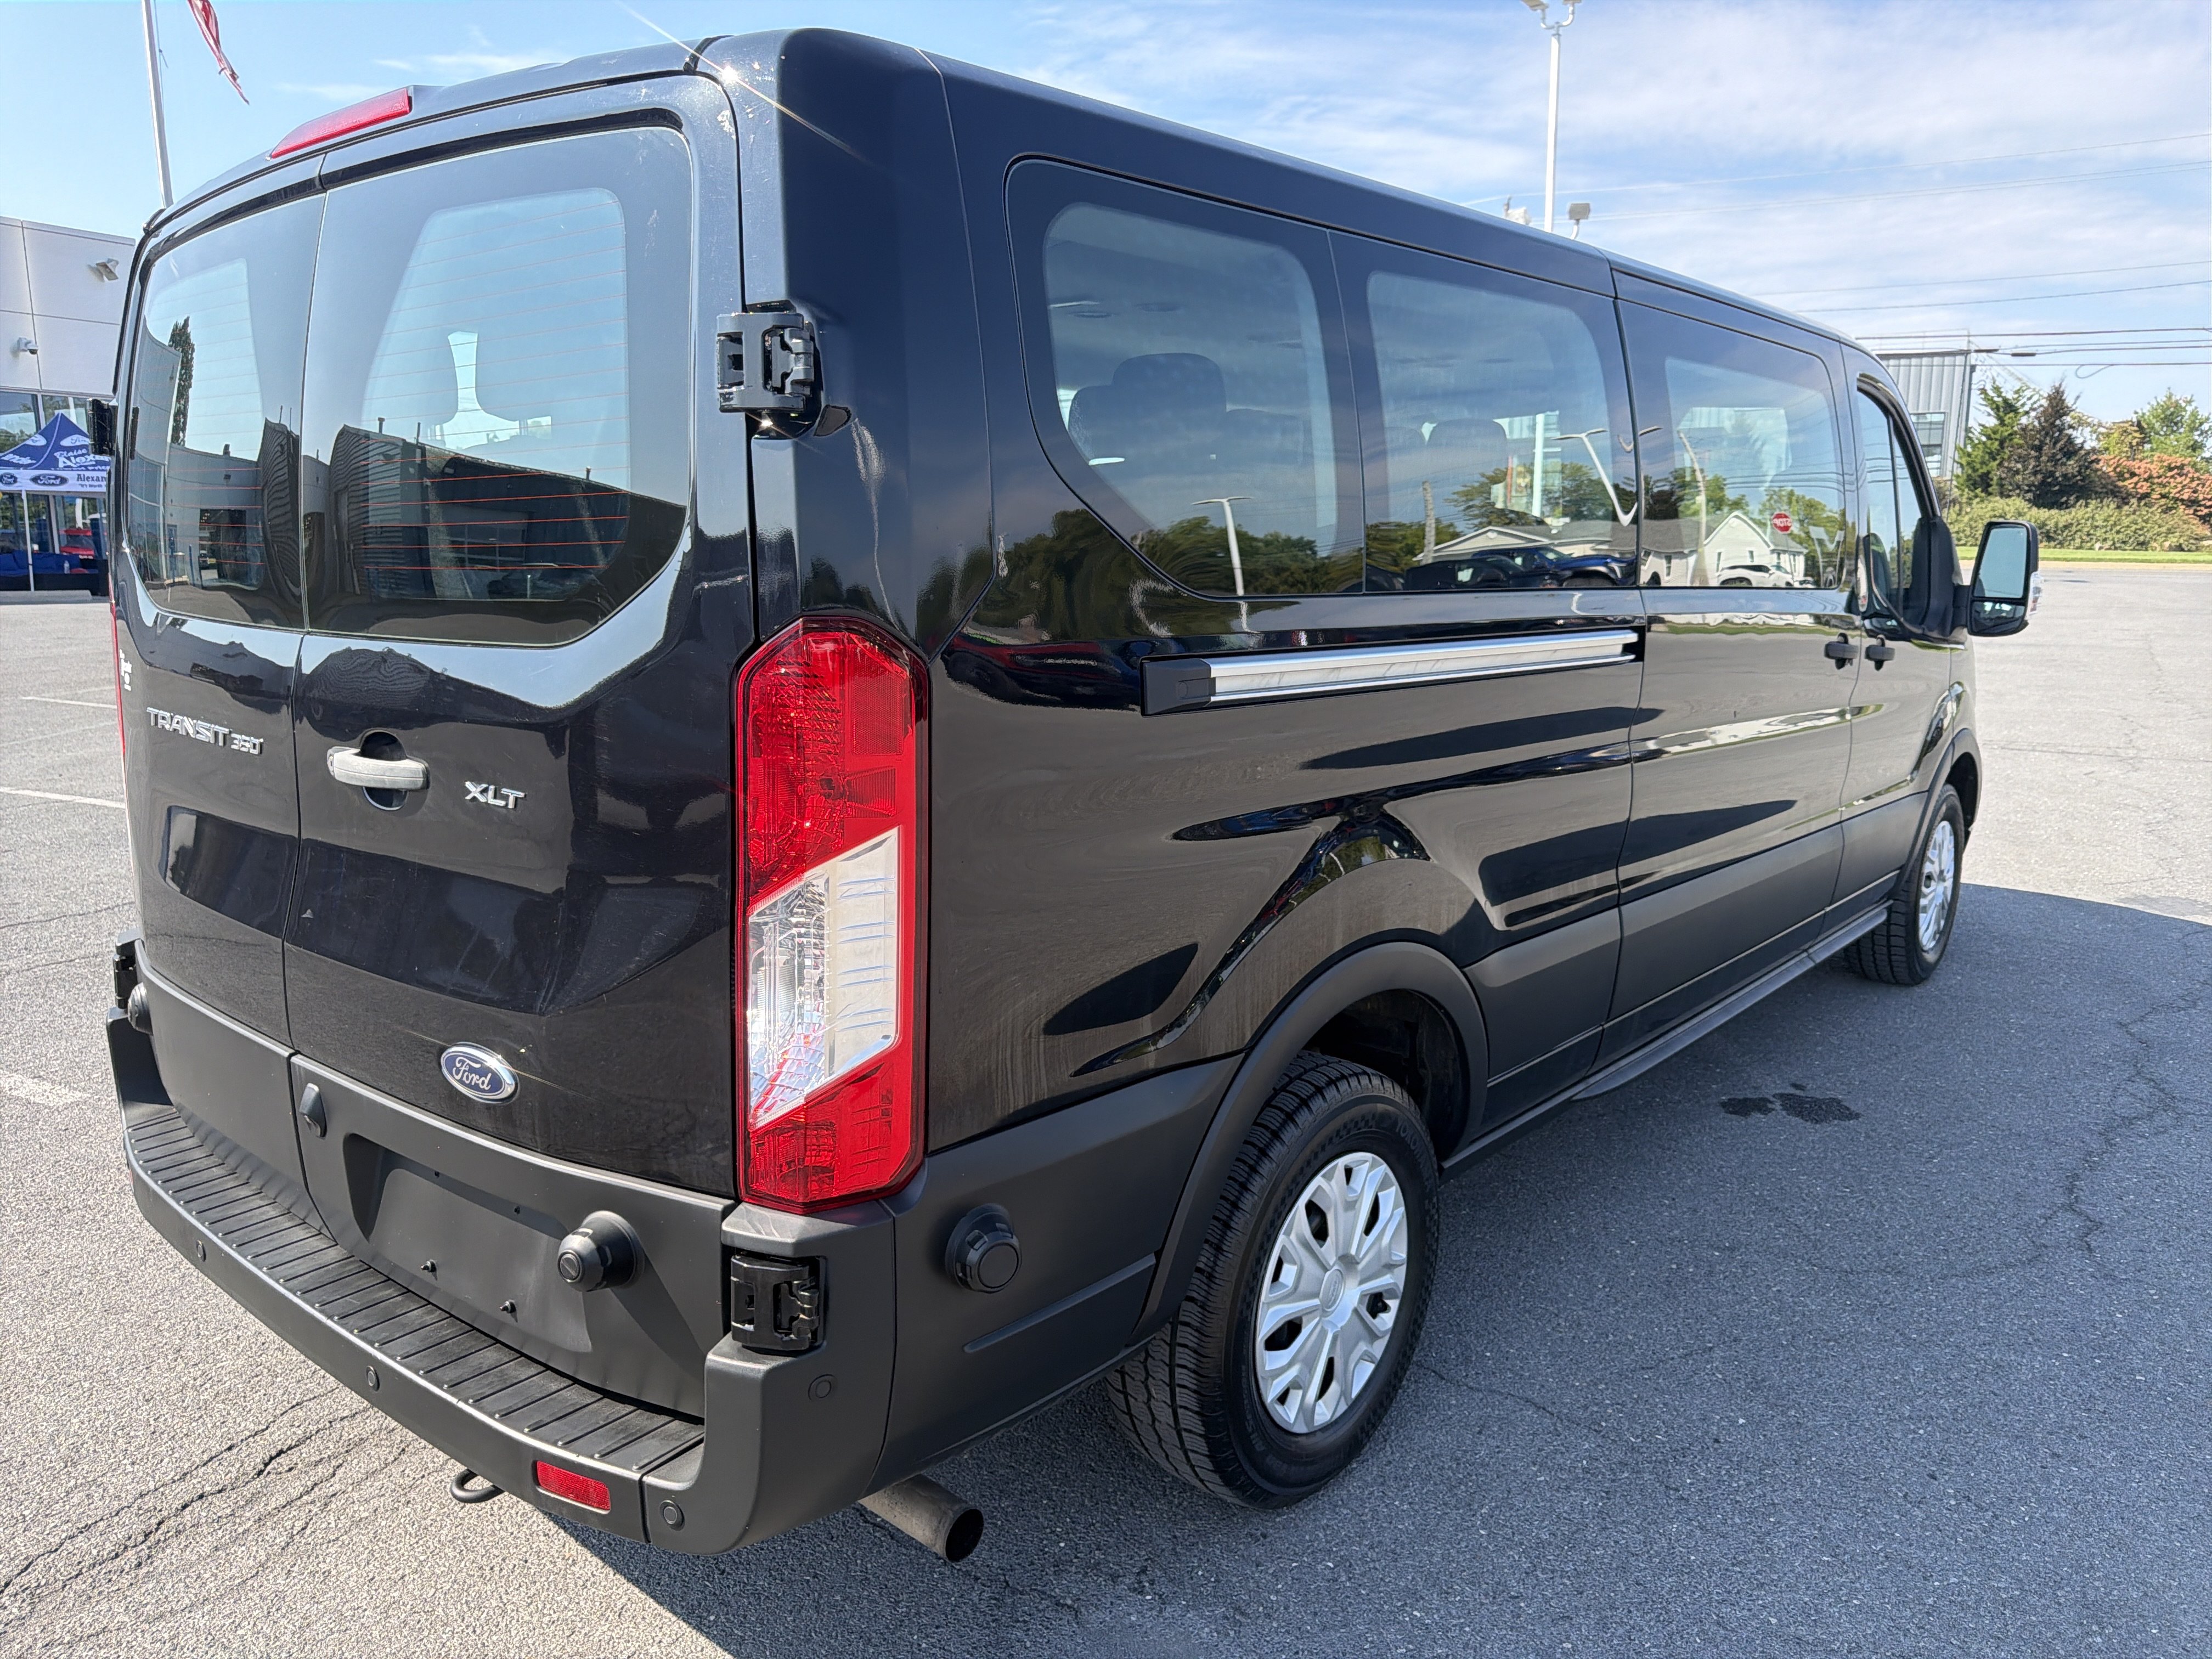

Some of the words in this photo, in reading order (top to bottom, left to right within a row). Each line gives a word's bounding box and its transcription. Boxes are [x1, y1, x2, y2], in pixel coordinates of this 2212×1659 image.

[37, 475, 60, 484] Ford
[146, 707, 229, 746] TRANSIT
[231, 733, 263, 755] 350
[465, 781, 525, 809] XLT
[453, 1057, 492, 1090] Ford
